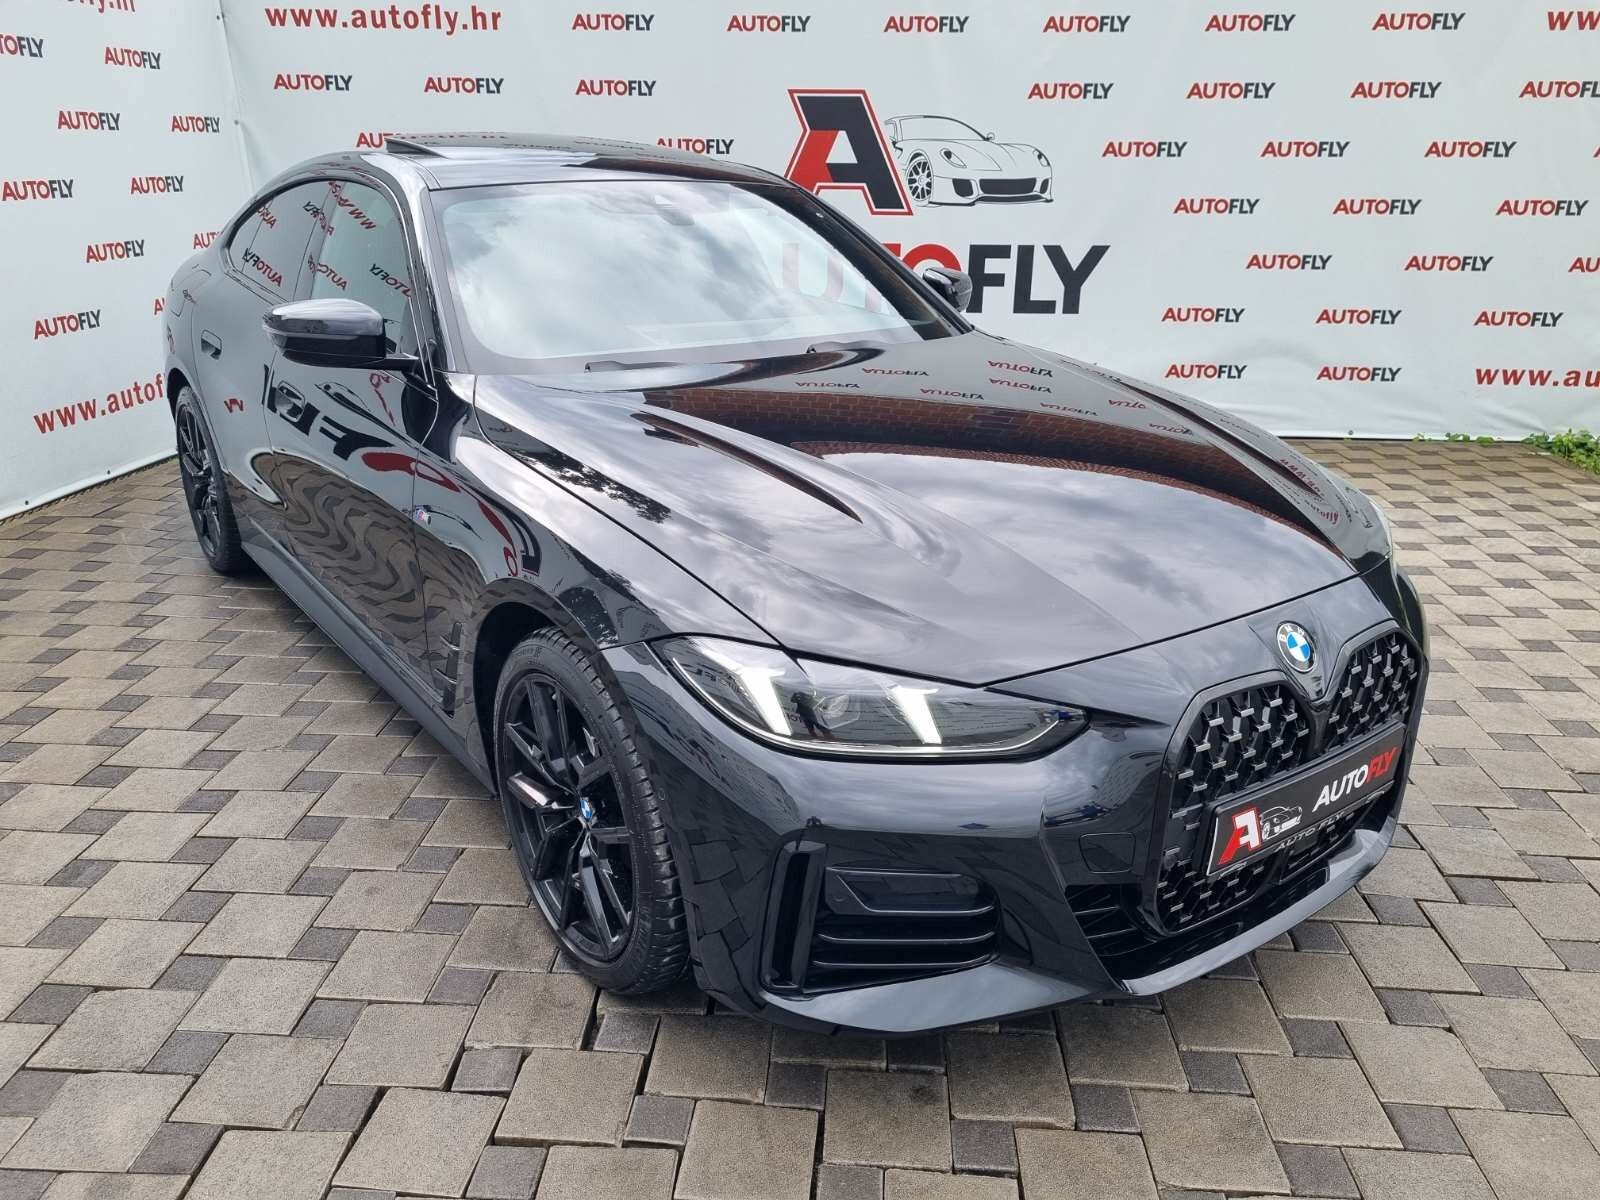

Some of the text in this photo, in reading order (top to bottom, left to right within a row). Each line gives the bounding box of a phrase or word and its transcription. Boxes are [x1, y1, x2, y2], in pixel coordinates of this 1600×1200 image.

[265, 4, 502, 36] www.autofly.hr
[572, 14, 654, 31] AUTOFLY
[727, 15, 811, 32] AUTOFLY
[884, 16, 969, 33] AUTOFLY
[1043, 16, 1131, 32] AUTOFLY
[1205, 14, 1296, 32] AUTOFLY
[1372, 13, 1466, 30] AUTOFLY
[105, 47, 161, 70] AUTOFLY
[274, 74, 352, 91] AUTOFLY
[424, 77, 504, 94] AUTOFLY
[576, 80, 656, 96] AUTOFLY
[1028, 83, 1114, 99] AUTOFLY
[1187, 82, 1276, 99] AUTOFLY
[1351, 82, 1442, 98] AUTOFLY
[1519, 81, 1600, 98] AUTOFL
[58, 111, 120, 131] AUTOFLY
[172, 116, 220, 133] AUTOFLY
[1102, 142, 1187, 157] AUTOFLY
[1261, 141, 1350, 157] AUTOFLY
[1424, 141, 1517, 157] AUTOFLY
[2, 179, 74, 201] AUTOFLY
[131, 176, 184, 194] AUTOFLY
[1174, 199, 1260, 214] AUTOFLY
[1333, 199, 1422, 215] AUTOFLY
[1496, 200, 1589, 216] AUTOFLY
[86, 240, 145, 263] AUTOFLY
[1246, 255, 1332, 270] AUTOFLY
[1404, 256, 1494, 271] AUTOFLY
[1161, 308, 1245, 322] AUTOFLY
[1316, 309, 1402, 324] AUTOFLY
[1474, 311, 1563, 327] AUTOFLY
[34, 309, 101, 340] AUTOFLY
[1165, 364, 1247, 379] AUTOFLY
[1317, 366, 1402, 382] AUTOFLY
[1312, 747, 1398, 812] AUTOFLY
